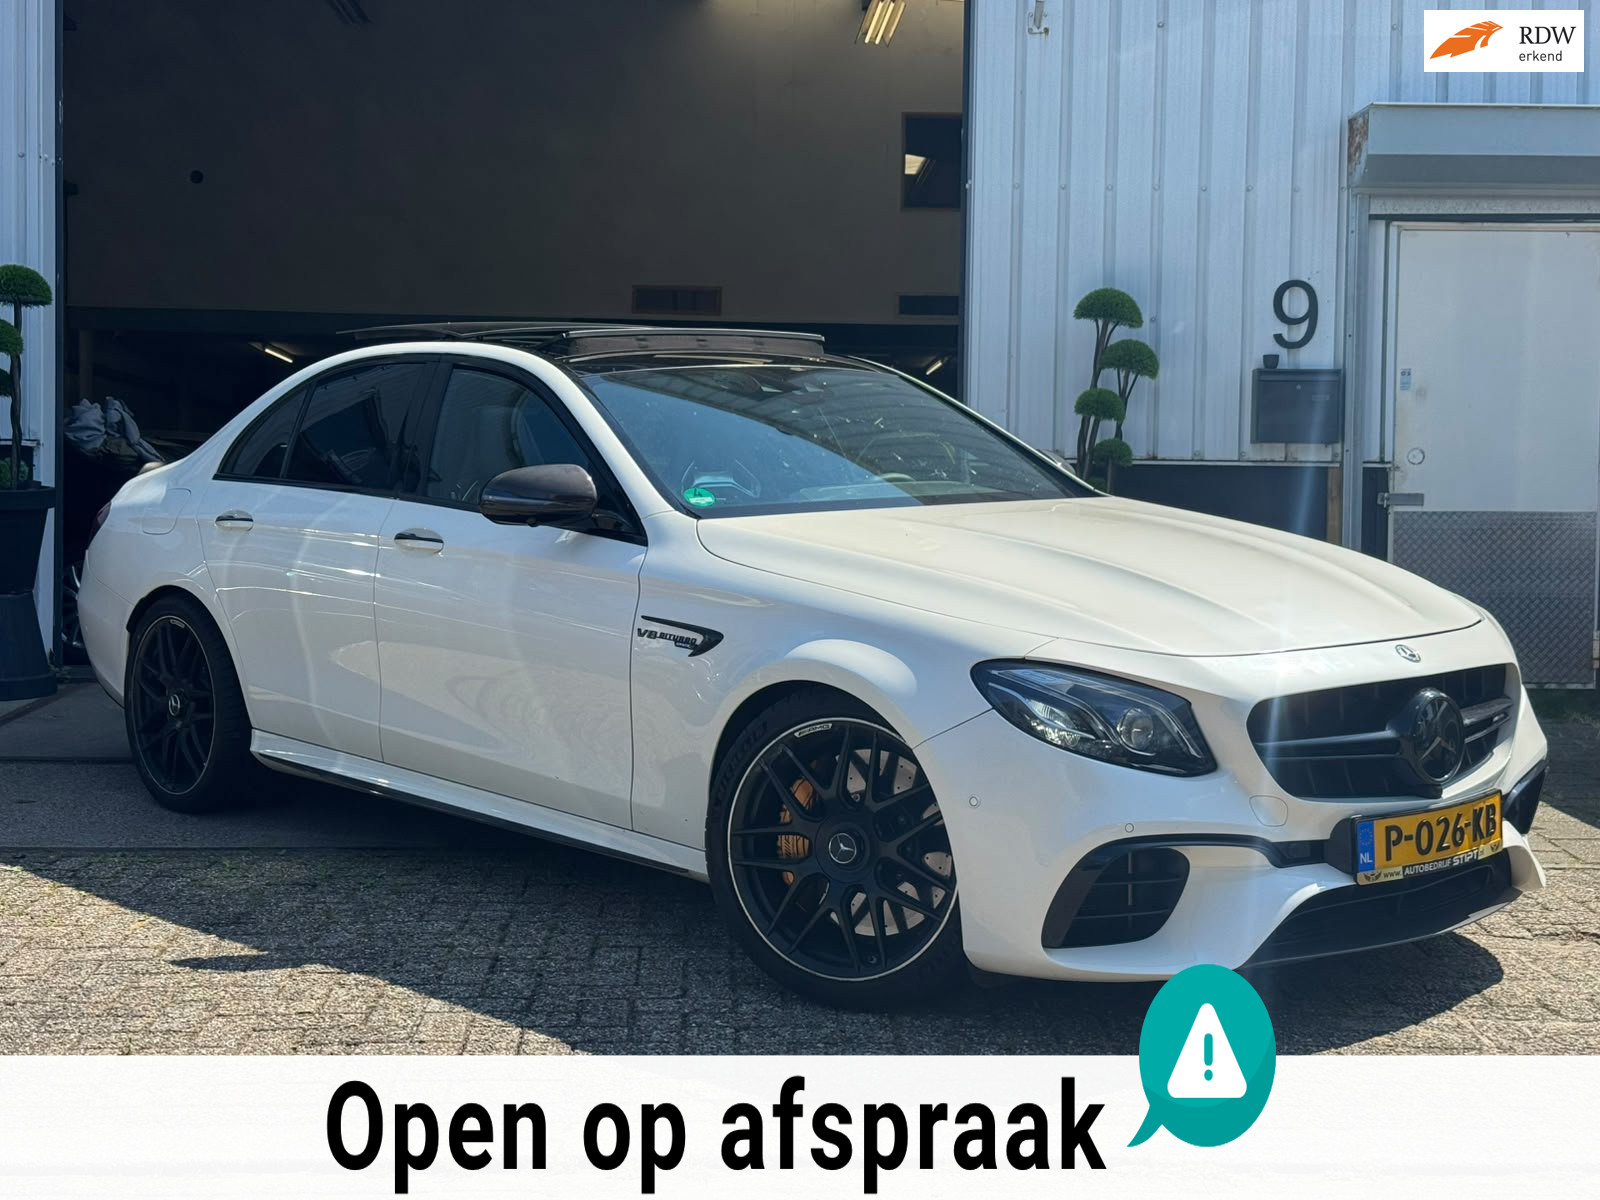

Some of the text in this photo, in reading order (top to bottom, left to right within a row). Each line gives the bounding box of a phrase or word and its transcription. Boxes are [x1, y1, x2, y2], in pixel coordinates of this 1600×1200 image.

[1273, 279, 1319, 350] 9
[637, 627, 658, 640] V8
[1385, 803, 1497, 862] P-026-KB
[1360, 852, 1373, 865] NL
[1403, 857, 1452, 876] AUTOBEDRIJF
[1453, 848, 1479, 867] STIPT
